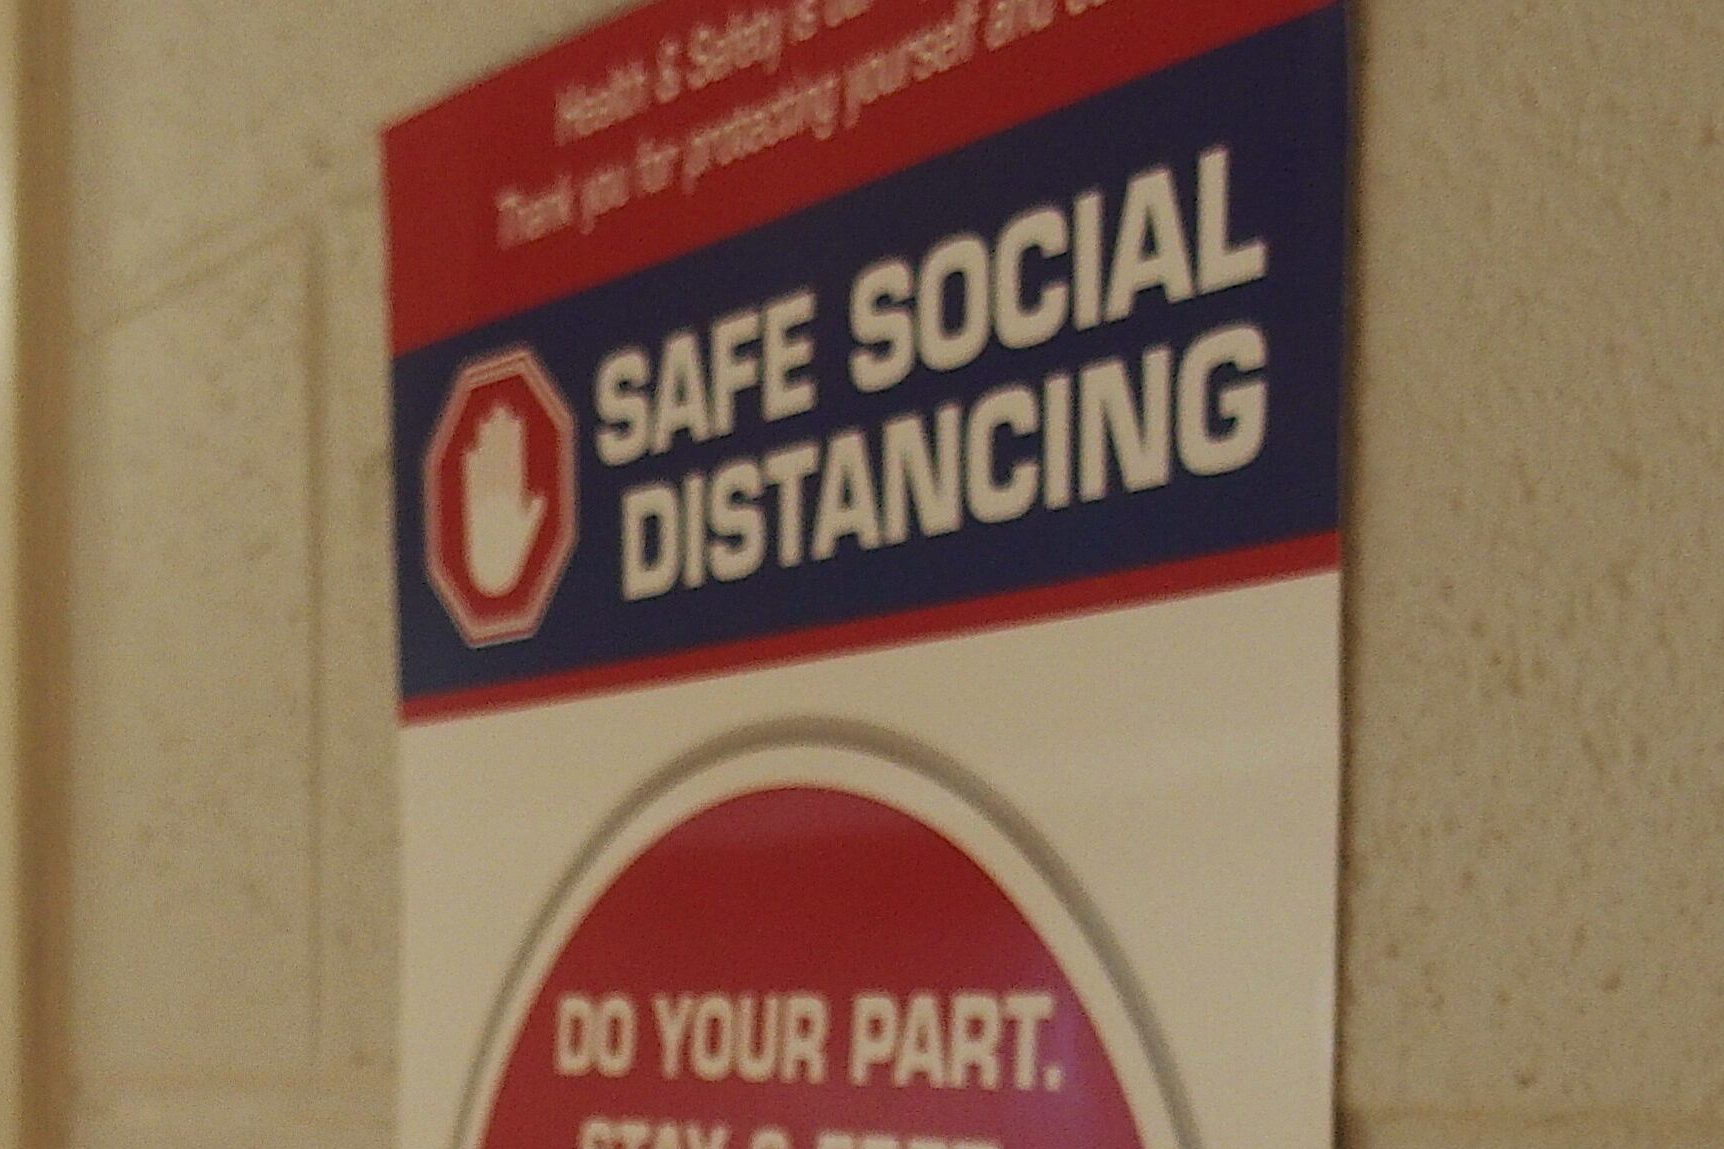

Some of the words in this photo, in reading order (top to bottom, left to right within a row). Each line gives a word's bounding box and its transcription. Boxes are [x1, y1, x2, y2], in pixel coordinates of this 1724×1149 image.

[594, 286, 819, 467] SAFE
[847, 147, 1268, 392] SOCIAL
[621, 323, 1268, 600] DISTANCING
[555, 991, 636, 1077] DO
[654, 990, 830, 1085] YOUR
[848, 990, 1064, 1091] PART.
